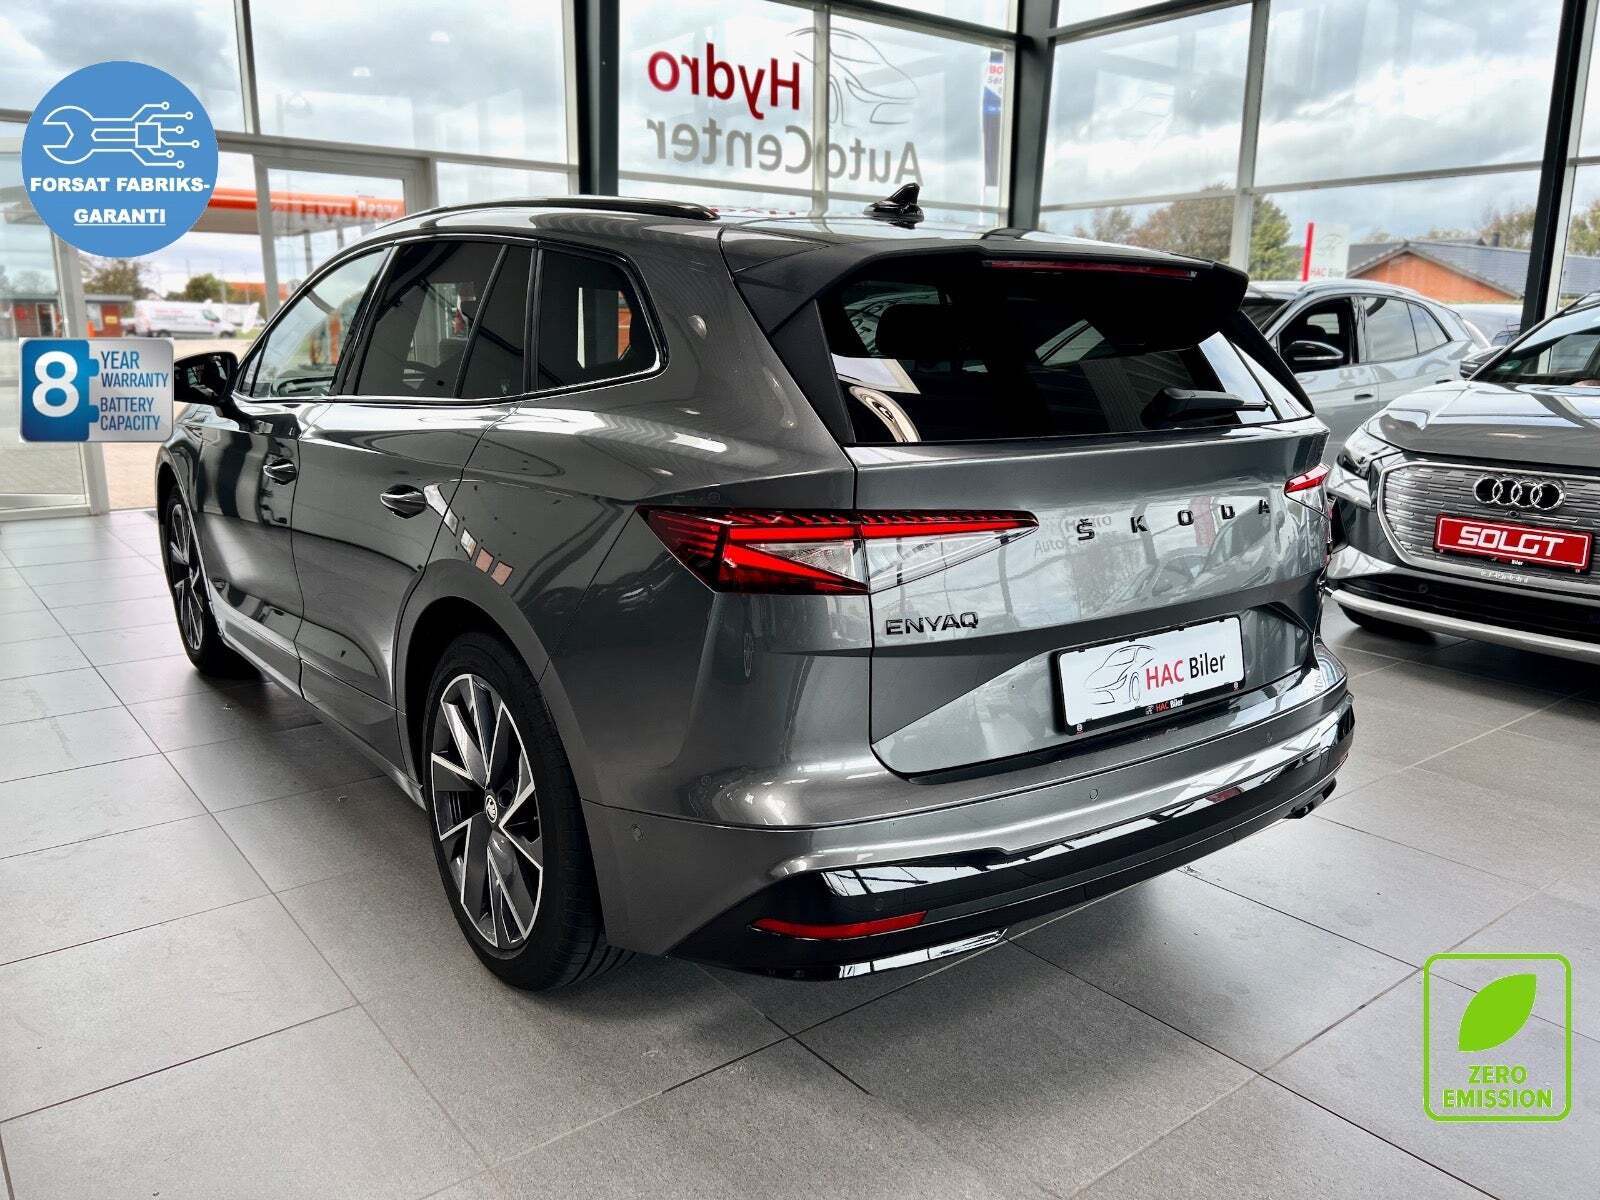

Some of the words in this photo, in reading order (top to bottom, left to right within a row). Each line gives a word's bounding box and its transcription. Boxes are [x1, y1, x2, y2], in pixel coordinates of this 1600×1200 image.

[1457, 525, 1564, 557] SOLGT
[886, 612, 979, 635] ENYAQ
[1146, 661, 1184, 689] HAC
[1189, 653, 1226, 679] Biler
[1155, 701, 1169, 712] HAC
